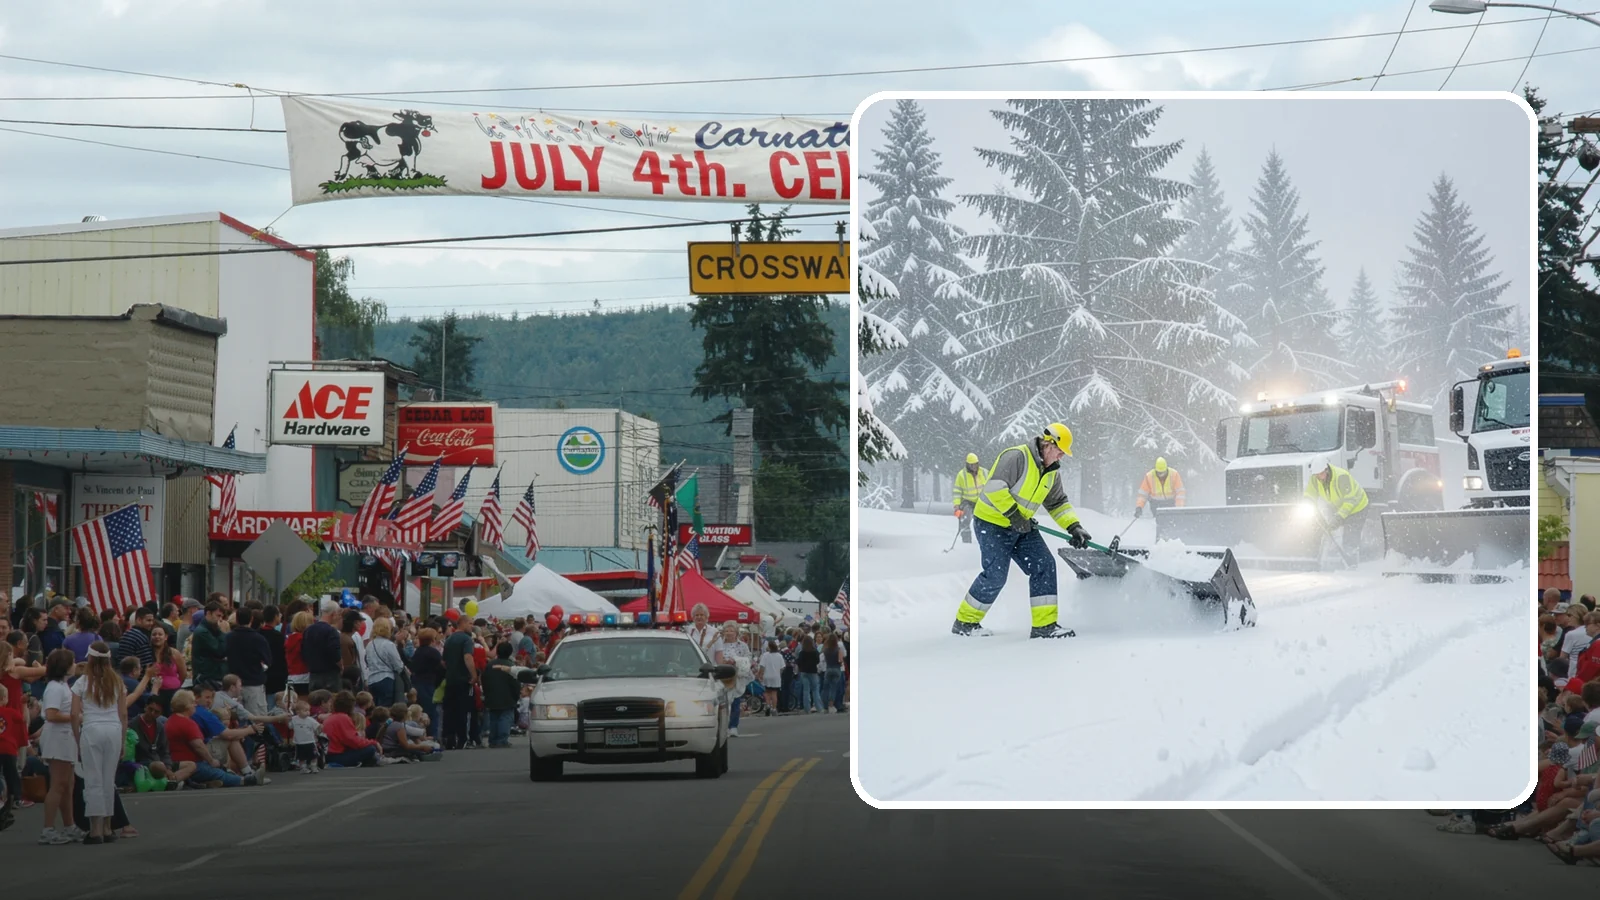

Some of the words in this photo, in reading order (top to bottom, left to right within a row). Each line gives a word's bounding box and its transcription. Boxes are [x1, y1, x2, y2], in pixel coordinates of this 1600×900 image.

[481, 141, 605, 192] JULY
[632, 150, 747, 198] 4th.
[283, 380, 373, 420] ACE
[405, 409, 452, 422] CEDAR
[461, 409, 485, 421] LOG
[283, 421, 370, 436] Hardware
[95, 485, 124, 494] Vincent
[126, 486, 136, 494] de
[138, 486, 155, 495] Paul
